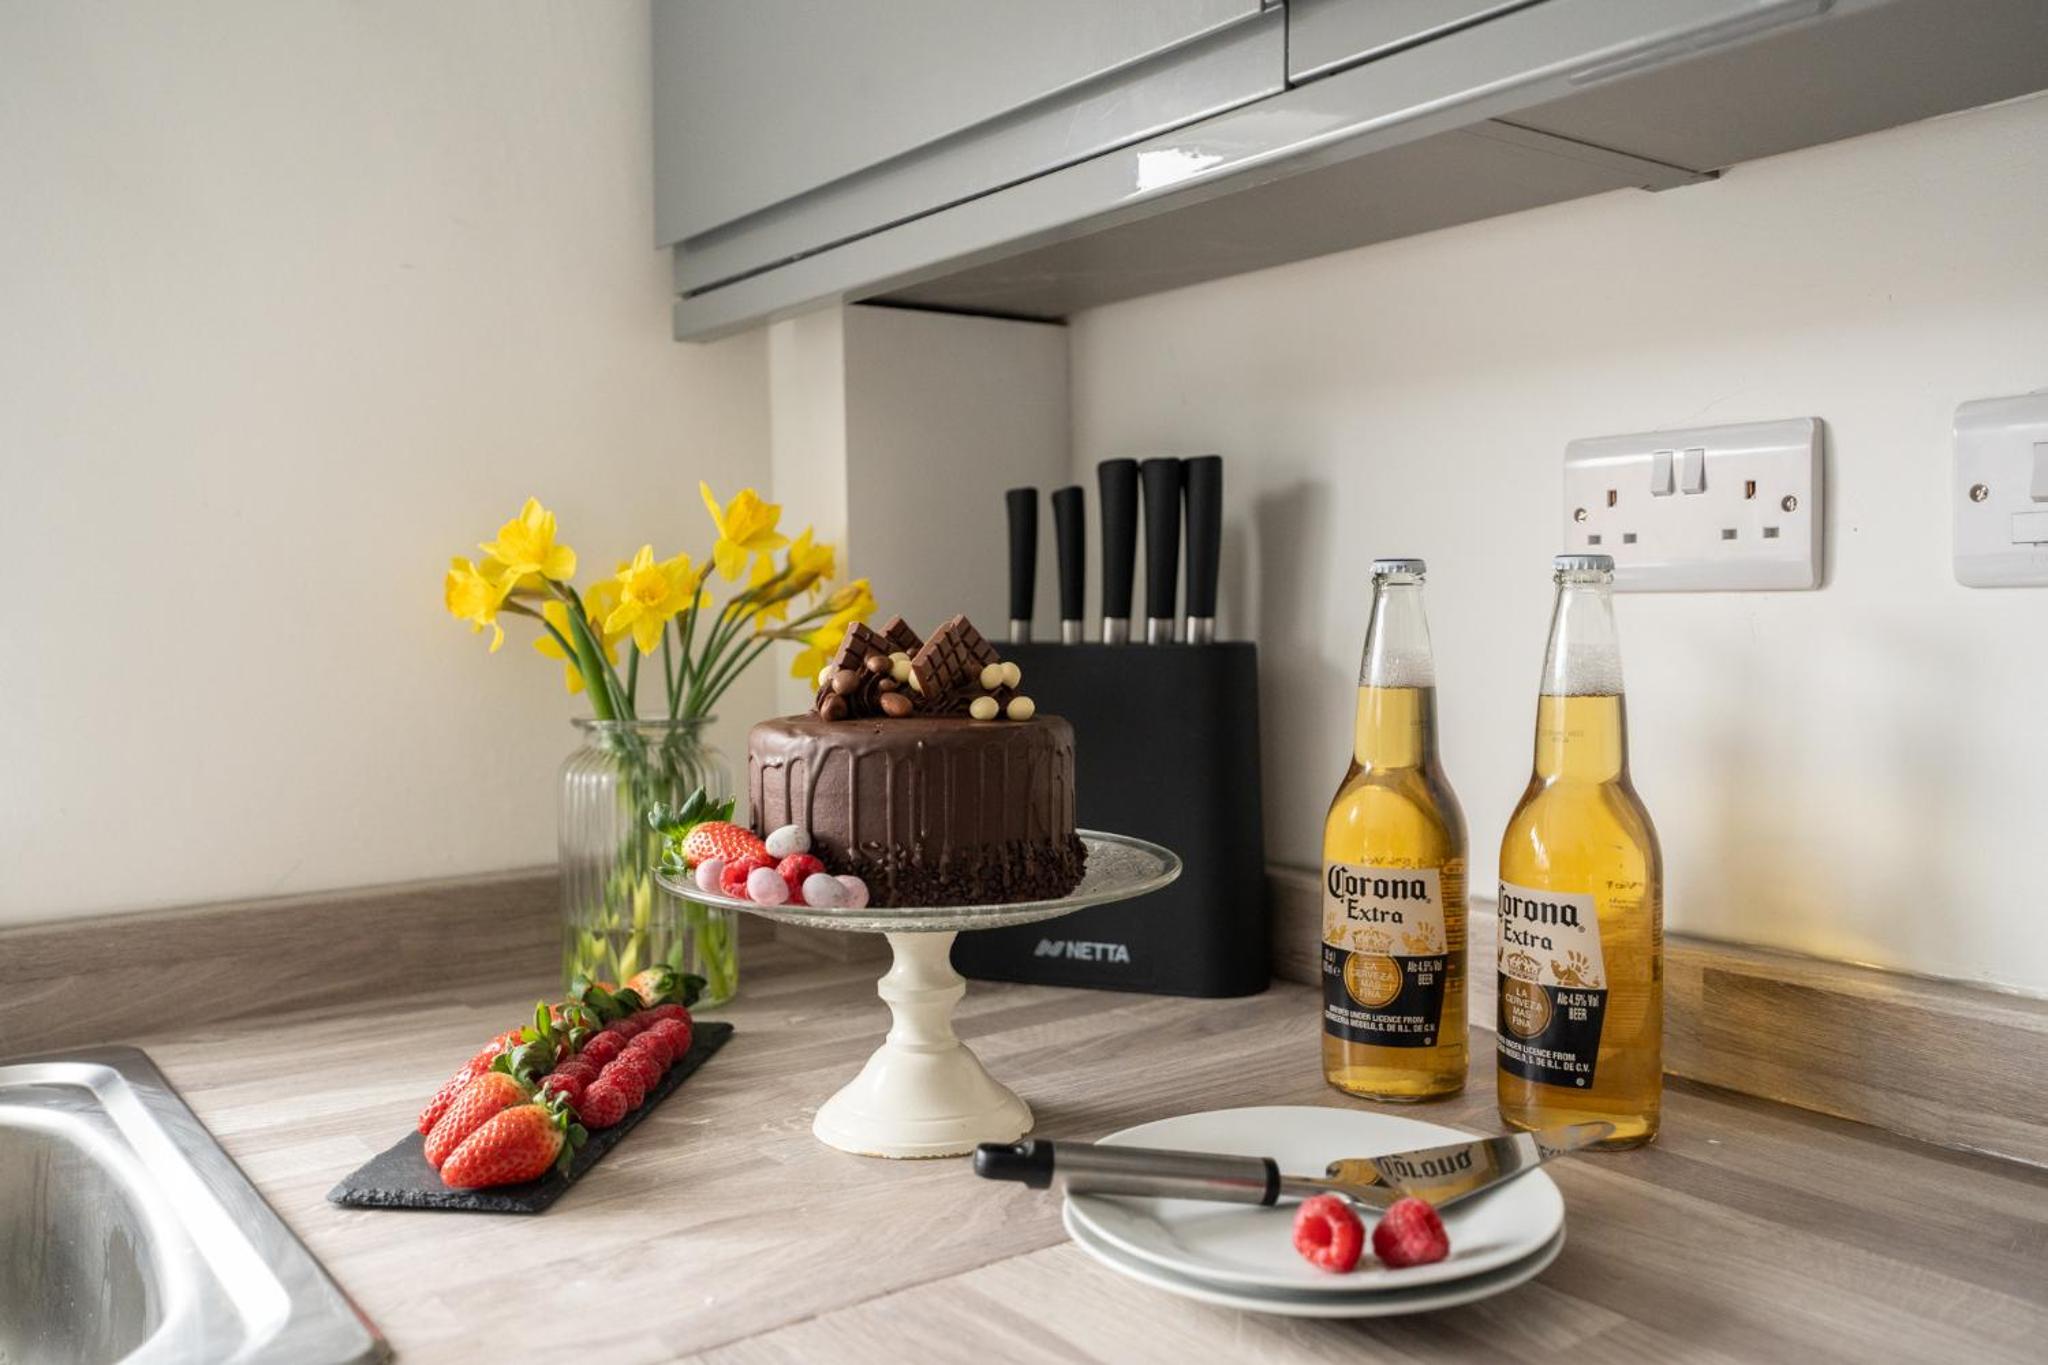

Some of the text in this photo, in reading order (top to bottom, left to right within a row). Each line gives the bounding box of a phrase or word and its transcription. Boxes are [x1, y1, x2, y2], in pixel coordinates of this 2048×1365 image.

[1328, 864, 1427, 902] Corona
[1347, 898, 1404, 924] Extra
[1503, 920, 1554, 951] Extra
[1065, 941, 1131, 964] NETTA
[1516, 987, 1528, 999] LA
[1557, 991, 1568, 1005] Alc
[1568, 993, 1587, 1007] 4.5%
[1372, 1013, 1401, 1023] LICENCE
[1403, 1016, 1424, 1024] FROM
[1512, 1015, 1532, 1029] FINA
[1569, 1007, 1587, 1021] BEER
[1523, 1045, 1552, 1058] LICENCE
[1552, 1051, 1576, 1062] FROM
[1536, 1056, 1546, 1067] DE
[1563, 1061, 1575, 1071] DE
[1575, 1063, 1590, 1073] C.V.
